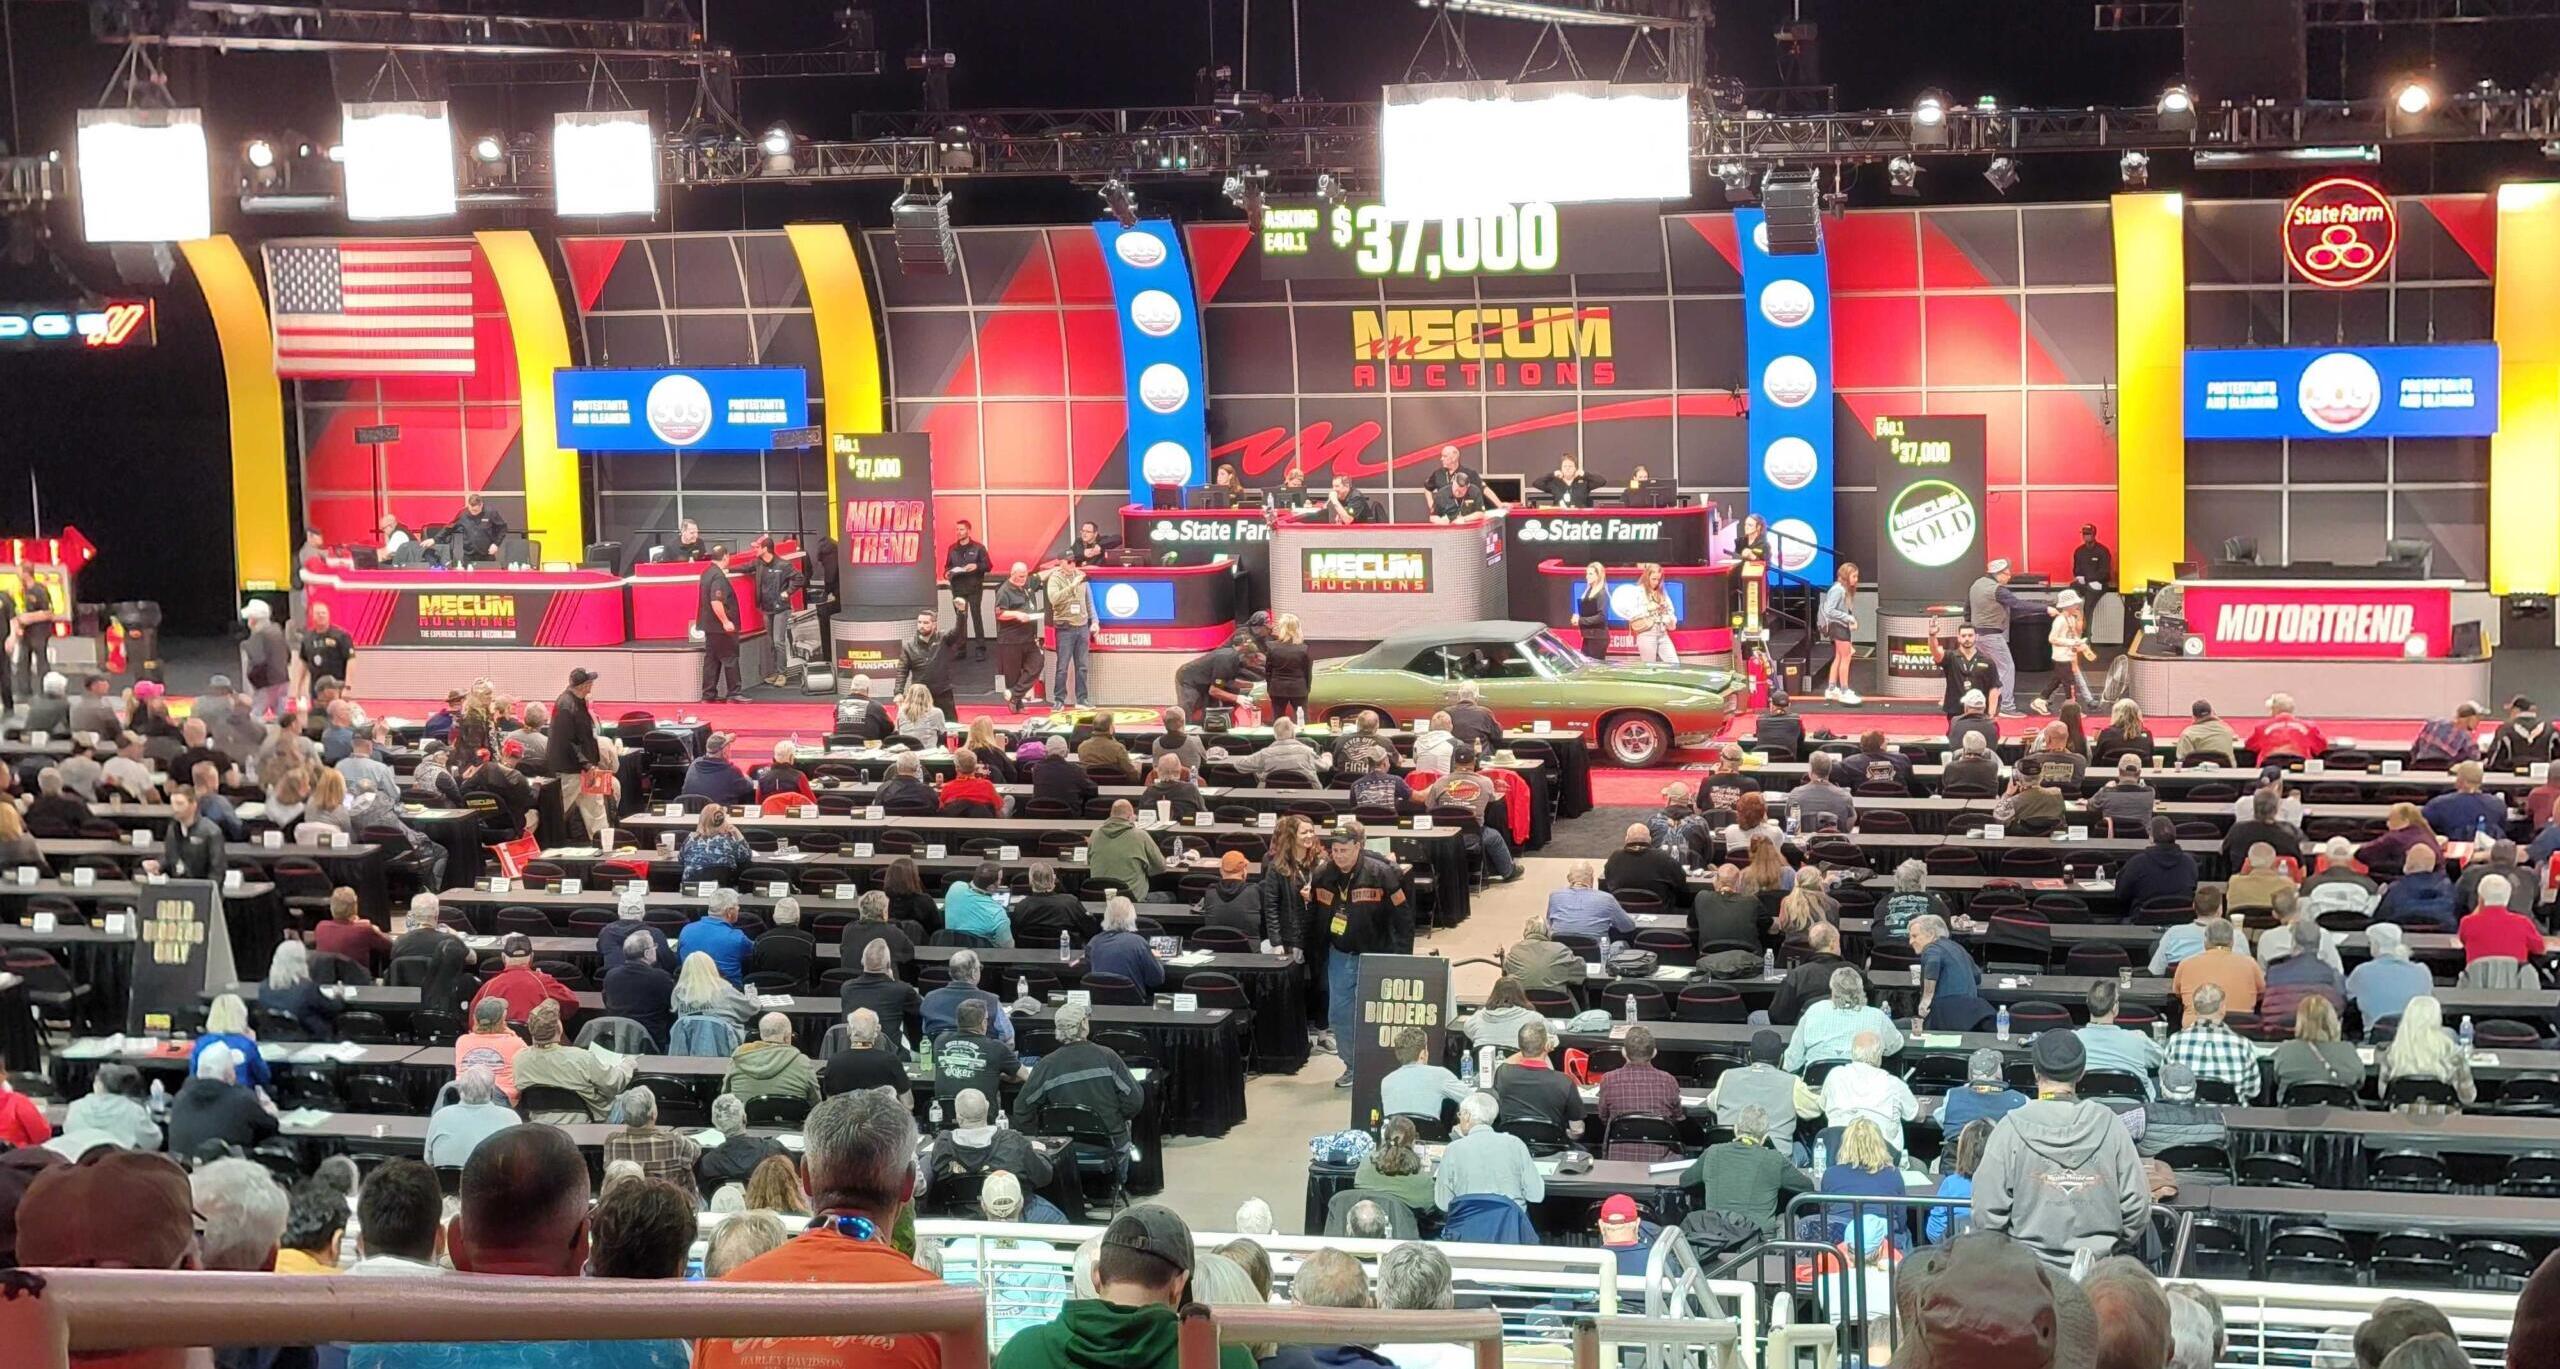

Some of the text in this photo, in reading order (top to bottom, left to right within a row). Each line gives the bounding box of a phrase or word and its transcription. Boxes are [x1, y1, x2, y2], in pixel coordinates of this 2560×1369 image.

[1264, 209, 1319, 229] ASKING
[2294, 203, 2384, 225] State Farm
[1264, 231, 1308, 251] E40.1
[1332, 201, 1558, 280] $37,000
[1352, 307, 1613, 360] MECUM
[1353, 362, 1616, 388] AUCTIONS
[1891, 437, 1951, 466] $37,000
[848, 454, 901, 481] $37,000
[846, 501, 925, 532] MOTOR
[1180, 519, 1270, 541] State Far
[1550, 519, 1658, 541] State Farm
[1901, 509, 1972, 553] SOLD
[851, 532, 920, 563] TREND
[1310, 553, 1424, 579] MECUM
[1311, 580, 1425, 591] AUCTIONS
[418, 595, 515, 616] MECUM
[419, 616, 516, 627] AUCTIONS
[2215, 603, 2415, 644] MOTORTREND
[1096, 632, 1151, 646] MECUM.COM
[853, 660, 899, 669] TRANSPORT
[1892, 654, 1936, 663] FINANC
[1344, 760, 1369, 774] FIGH
[1381, 978, 1425, 1001] GOLD
[1364, 1001, 1438, 1026] BIDDERS
